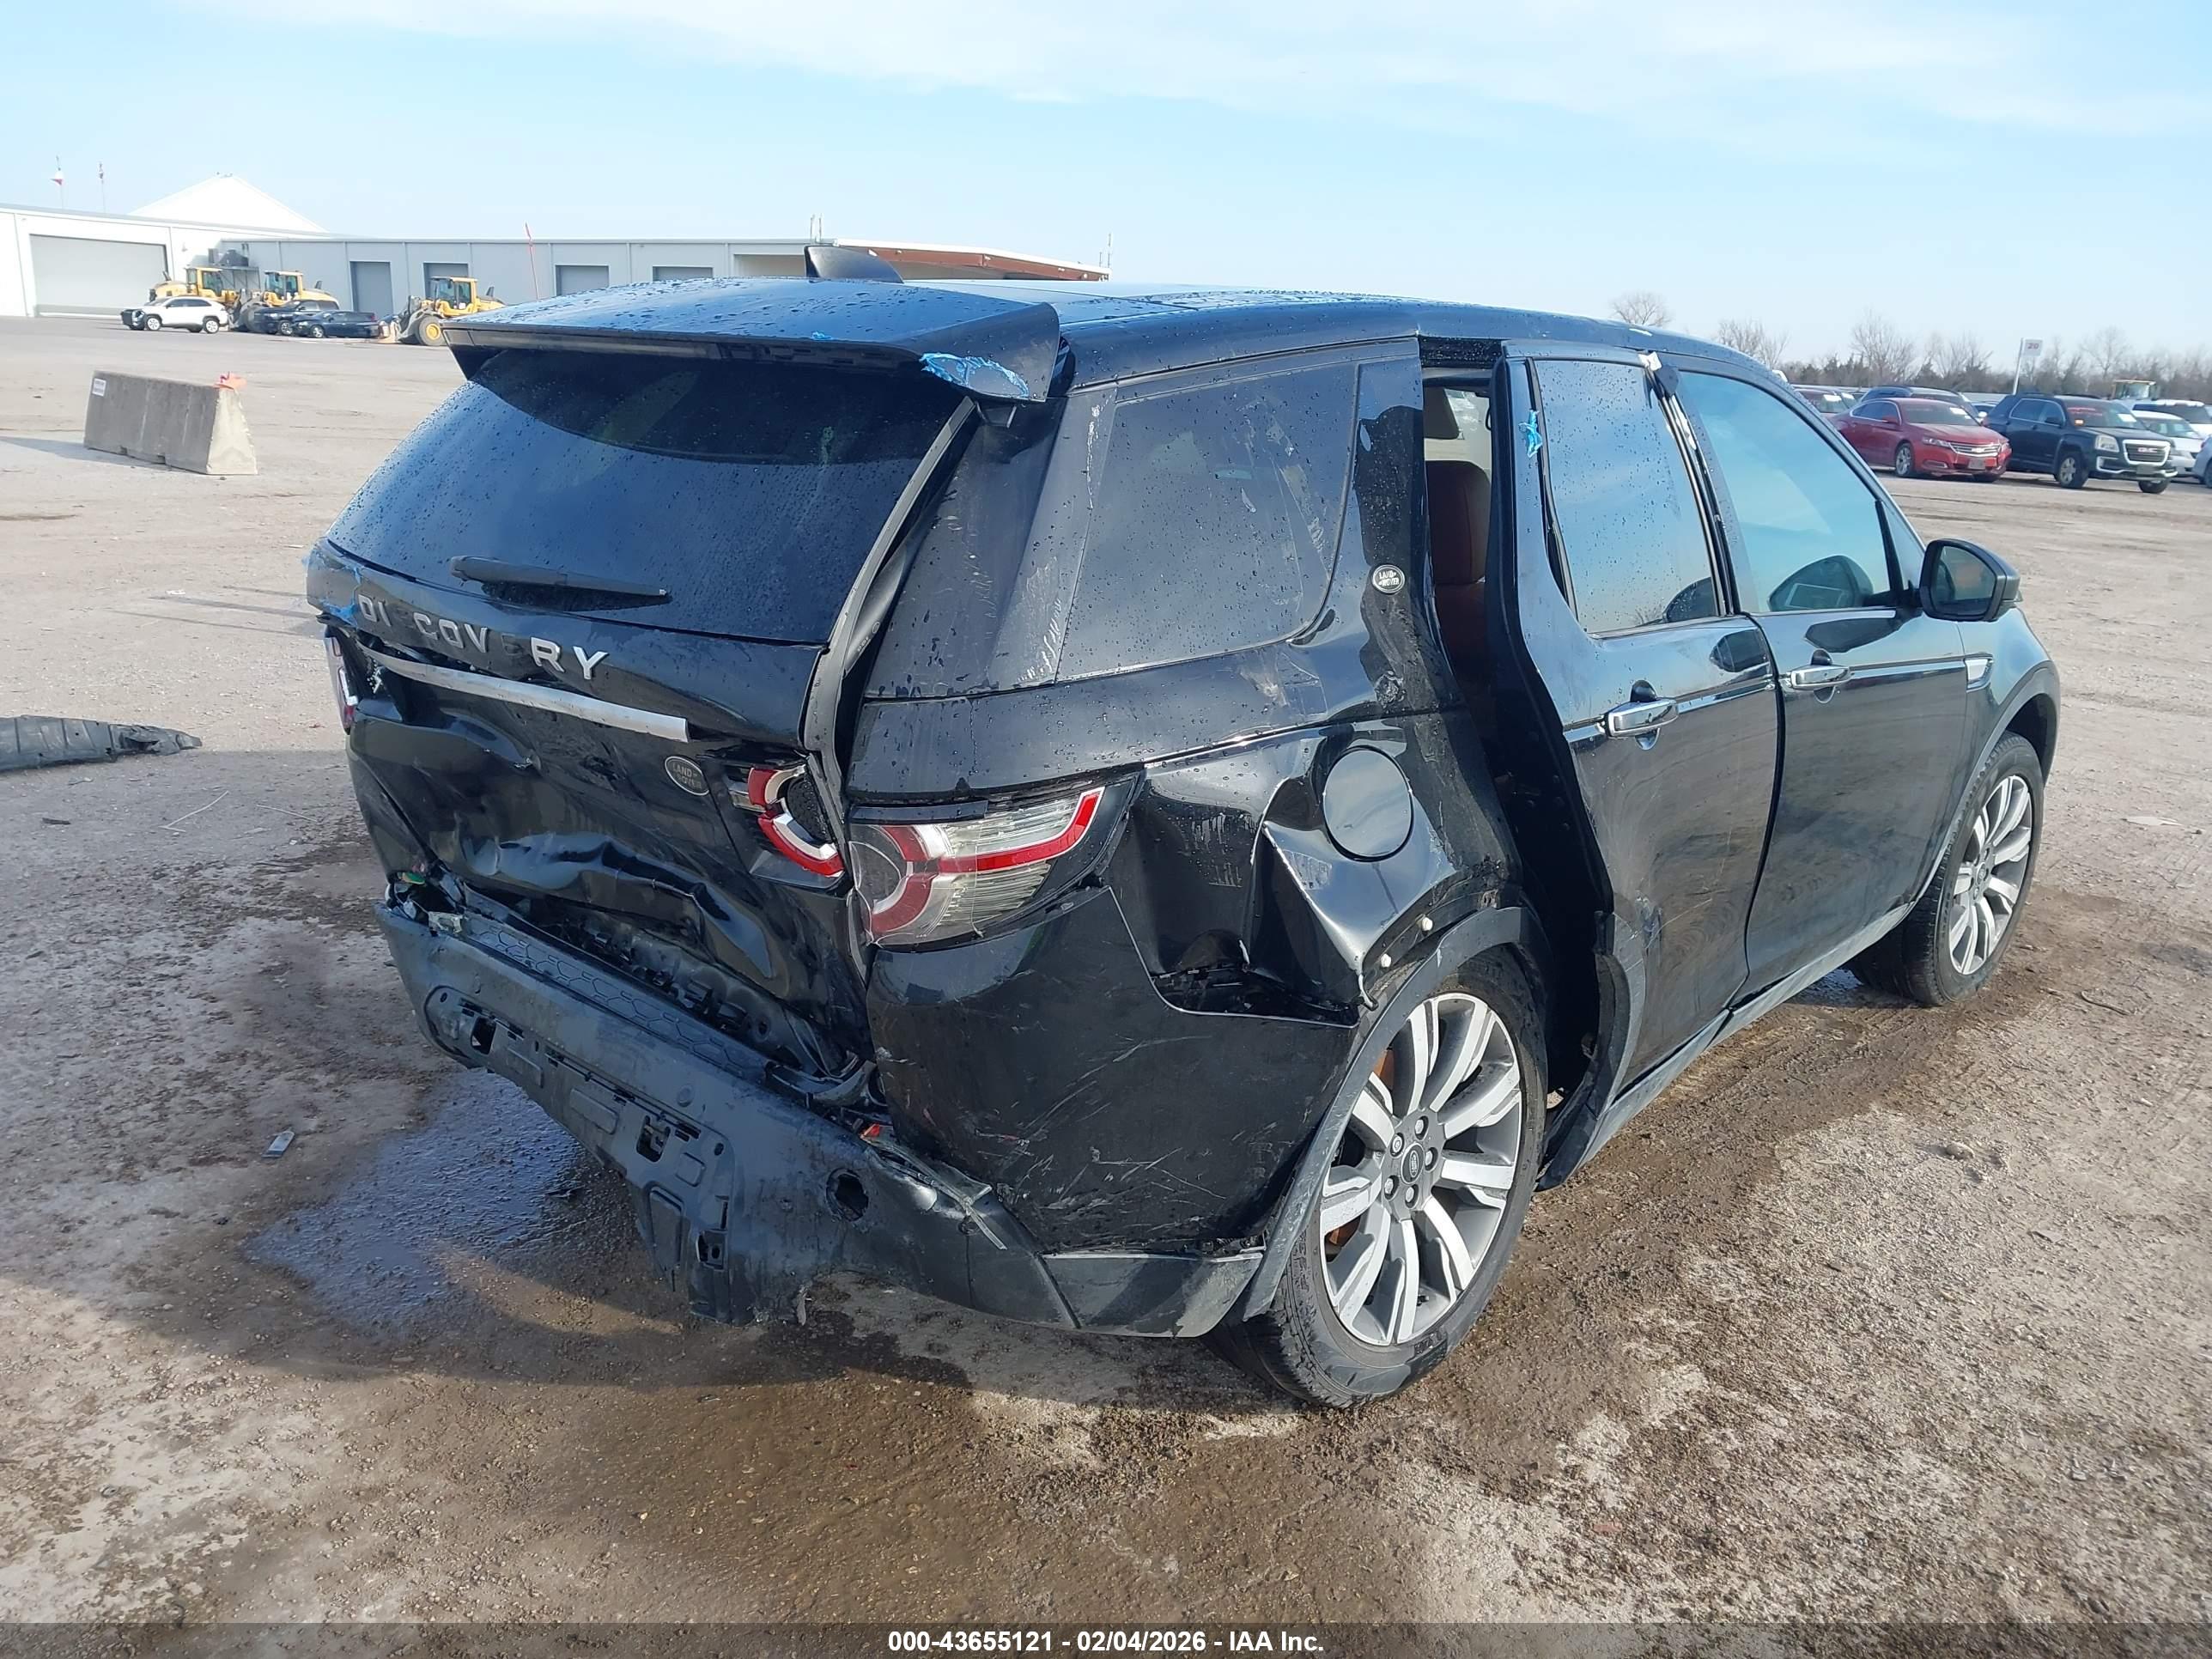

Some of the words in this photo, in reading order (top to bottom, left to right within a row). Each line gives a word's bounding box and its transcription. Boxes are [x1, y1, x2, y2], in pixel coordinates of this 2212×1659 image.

[1378, 570, 1394, 580] LAND
[357, 593, 609, 680] DICOVRY
[672, 763, 692, 778] LAND
